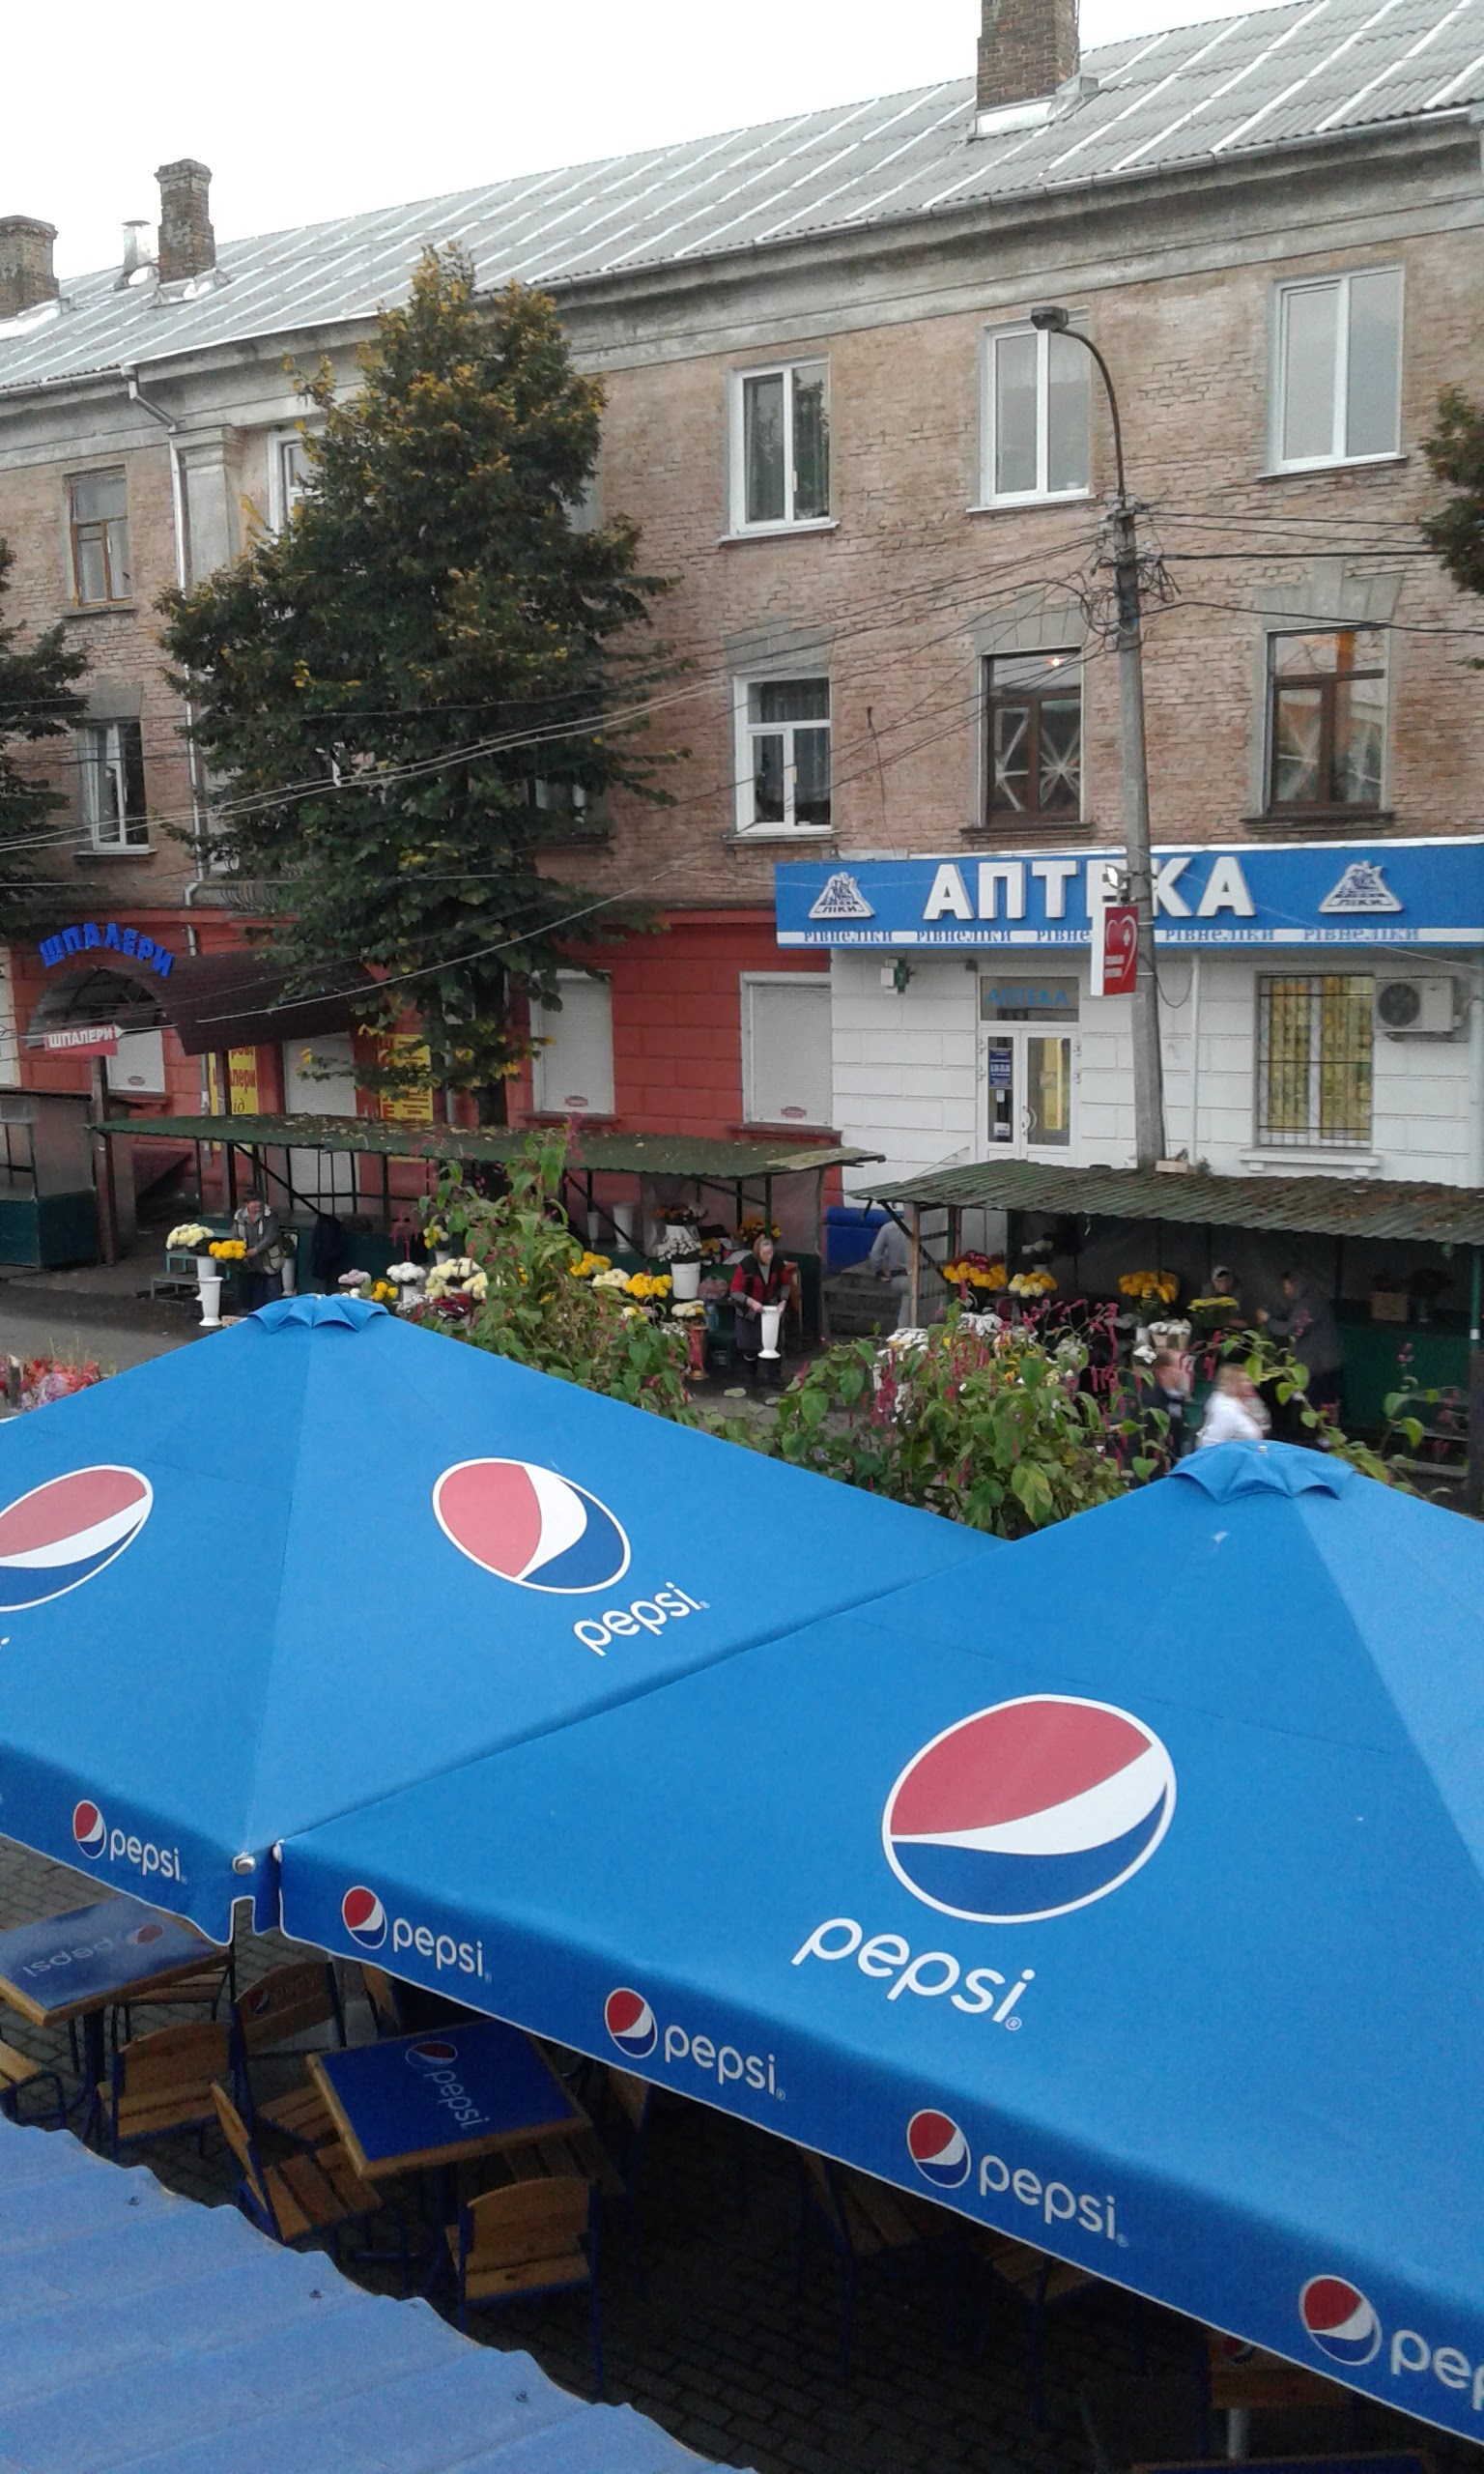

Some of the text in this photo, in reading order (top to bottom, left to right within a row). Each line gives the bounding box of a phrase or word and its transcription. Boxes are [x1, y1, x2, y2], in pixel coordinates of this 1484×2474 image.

[922, 856, 1256, 921] АПТЕКА
[40, 922, 175, 978] ШПАЛЕРИ
[49, 1026, 113, 1049] ШПАЛЕРИ
[573, 1581, 703, 1656] pepsi
[110, 1827, 181, 1882] pepsi
[21, 1937, 115, 1978] pepsi
[392, 1917, 483, 1978] pepsi
[791, 1916, 1036, 2024] pepsi
[665, 2024, 776, 2095] pepsi
[423, 2069, 491, 2130] pepsi
[980, 2154, 1116, 2240] pepsi
